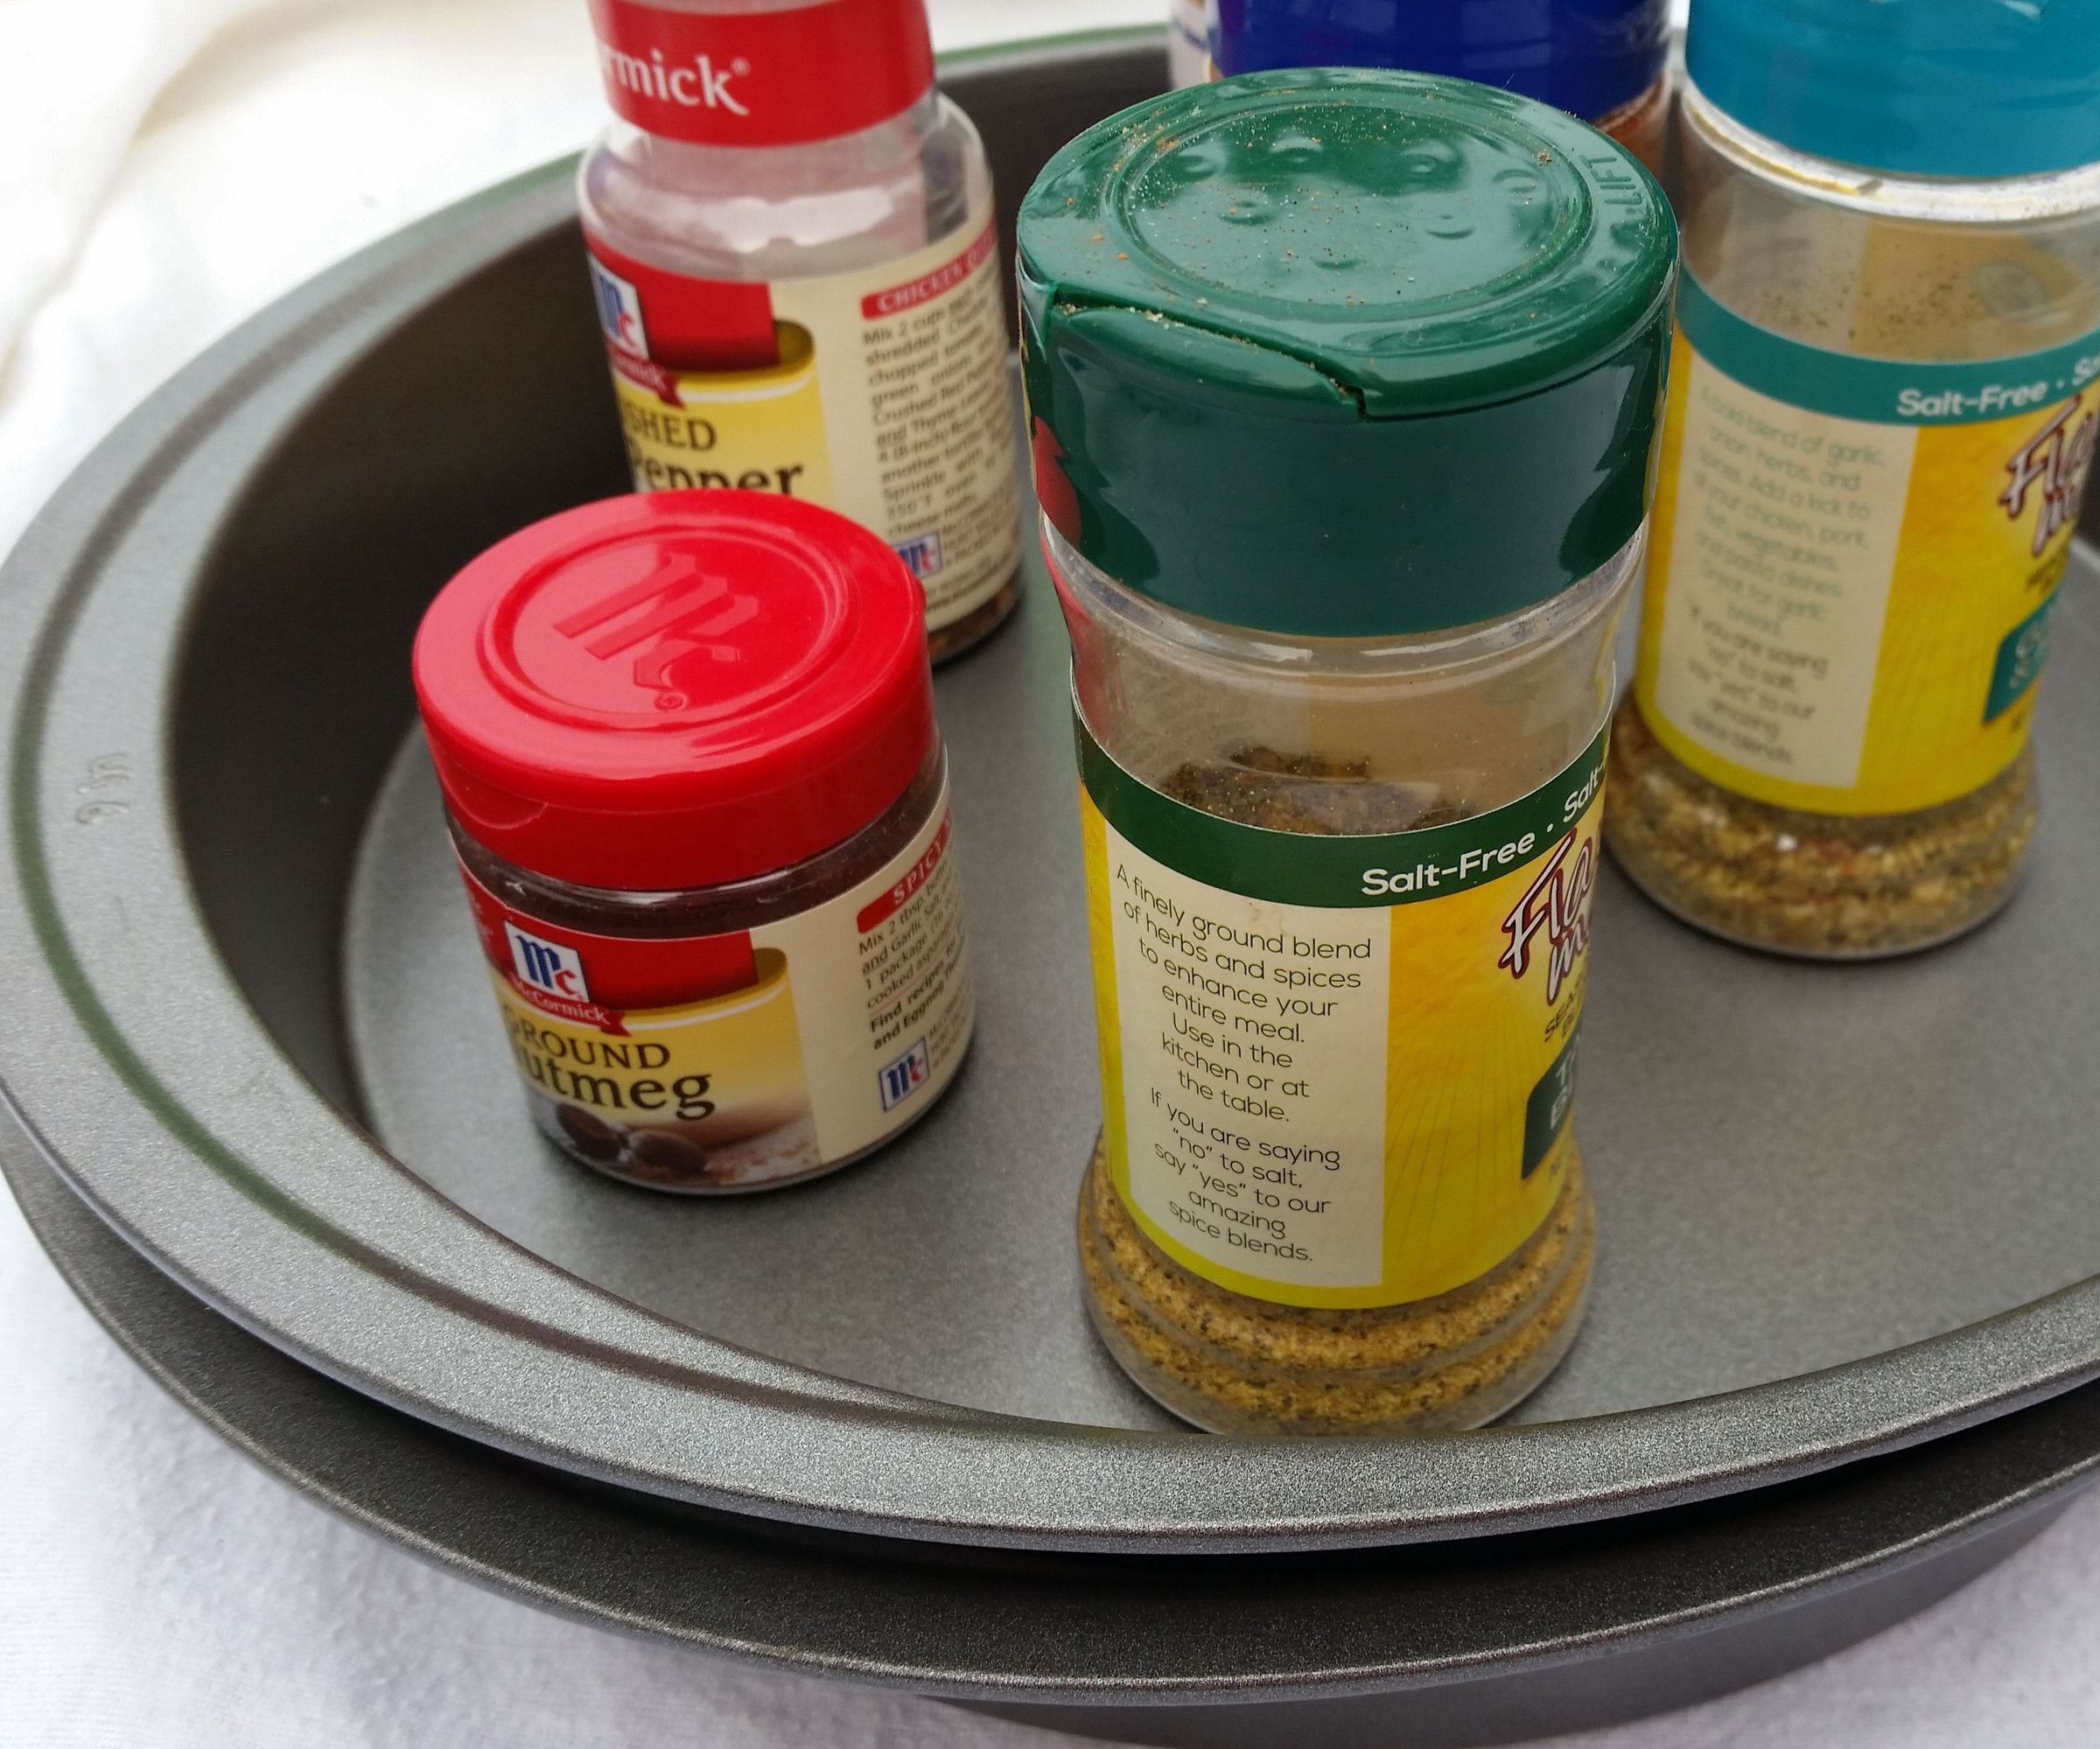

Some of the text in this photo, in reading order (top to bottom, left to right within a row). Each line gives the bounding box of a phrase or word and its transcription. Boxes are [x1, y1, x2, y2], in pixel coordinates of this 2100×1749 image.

[1896, 381, 2048, 416] Salt-Free
[625, 440, 805, 495] epper
[1362, 832, 1536, 896] Salt-Free
[858, 931, 885, 955] Mix
[889, 920, 897, 936] 2
[1117, 864, 1371, 959] A finely ground blend
[863, 946, 889, 975] and
[892, 920, 923, 952] Garlic
[880, 933, 928, 985] package
[1146, 913, 1208, 962] herbs
[1215, 954, 1264, 980] and
[1274, 967, 1362, 989] spices
[868, 963, 914, 1009] cooked
[1139, 938, 1339, 1017] to enhance your
[871, 1001, 902, 1033] Find
[874, 1022, 901, 1050] and
[1162, 984, 1305, 1043] entire meal.
[1172, 1012, 1292, 1068] Use in the
[521, 1044, 716, 1121] utmeg
[1162, 1032, 1310, 1098] kitchen or at
[1178, 1070, 1290, 1123] the table.
[1151, 1087, 1340, 1171] If you are saying
[1154, 1143, 1186, 1175] say
[1254, 1188, 1280, 1207] to
[1288, 1198, 1332, 1214] our
[1221, 1153, 1245, 1174] to
[1253, 1164, 1303, 1188] salt,
[1169, 1200, 1313, 1261] spice blends.
[1189, 1190, 1285, 1240] amazing
